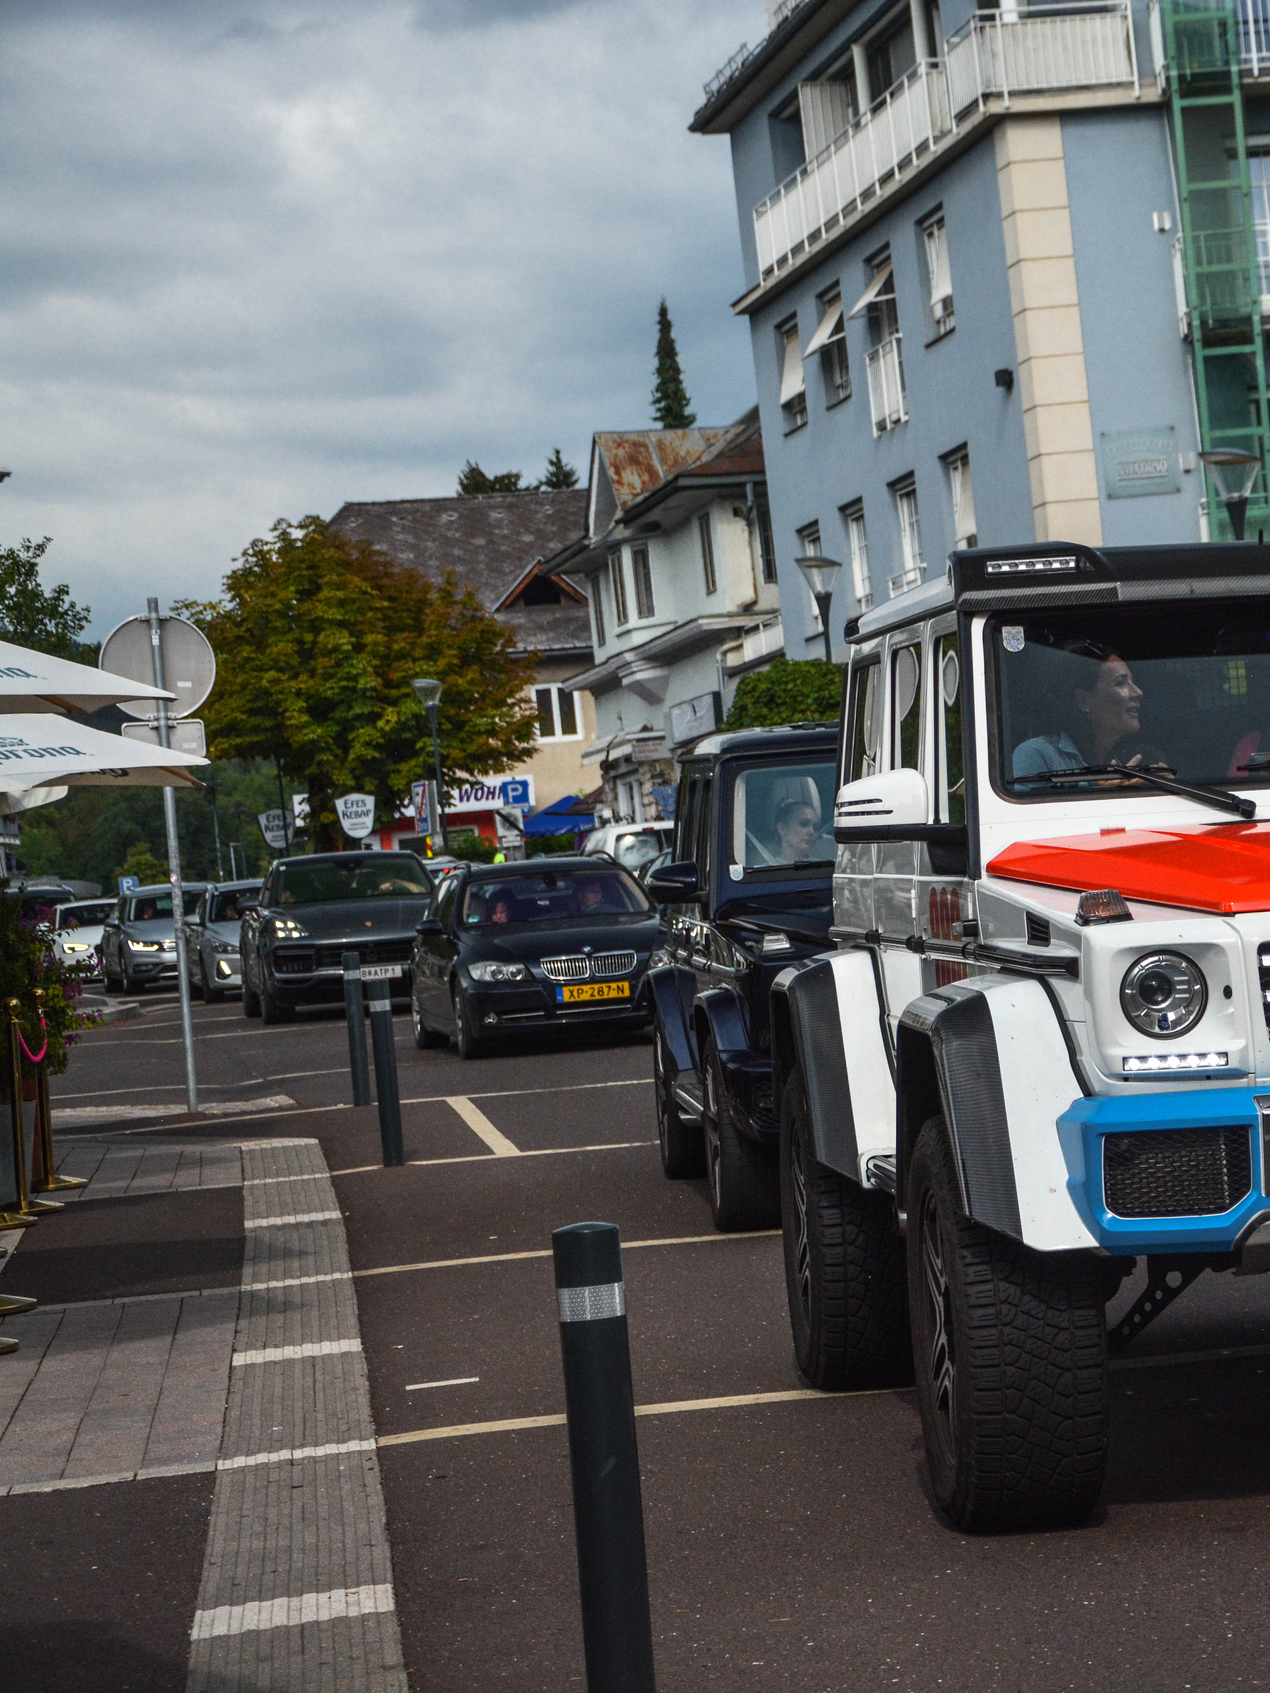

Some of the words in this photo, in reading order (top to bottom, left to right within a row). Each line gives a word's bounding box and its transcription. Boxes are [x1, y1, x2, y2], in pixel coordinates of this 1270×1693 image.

[0, 746, 87, 763] orona
[507, 784, 523, 803] P
[342, 809, 372, 820] KEBAP
[568, 984, 625, 1000] XP-287-N
